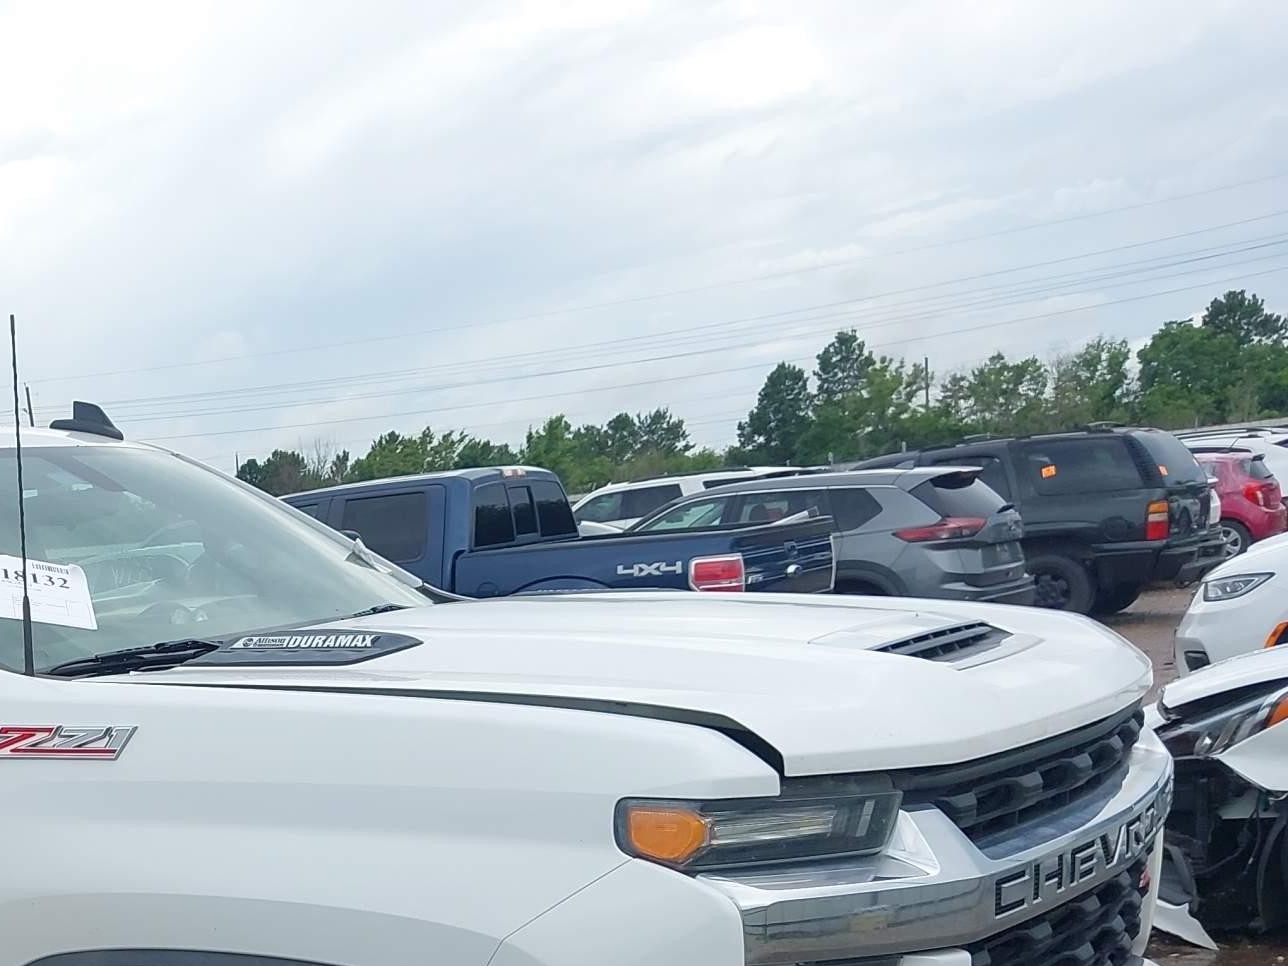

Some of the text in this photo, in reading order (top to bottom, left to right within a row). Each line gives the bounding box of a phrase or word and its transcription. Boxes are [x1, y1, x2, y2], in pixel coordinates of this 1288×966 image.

[616, 561, 683, 577] 4X4
[286, 635, 379, 649] DURAMAX
[994, 776, 1173, 920] CHEVRO
